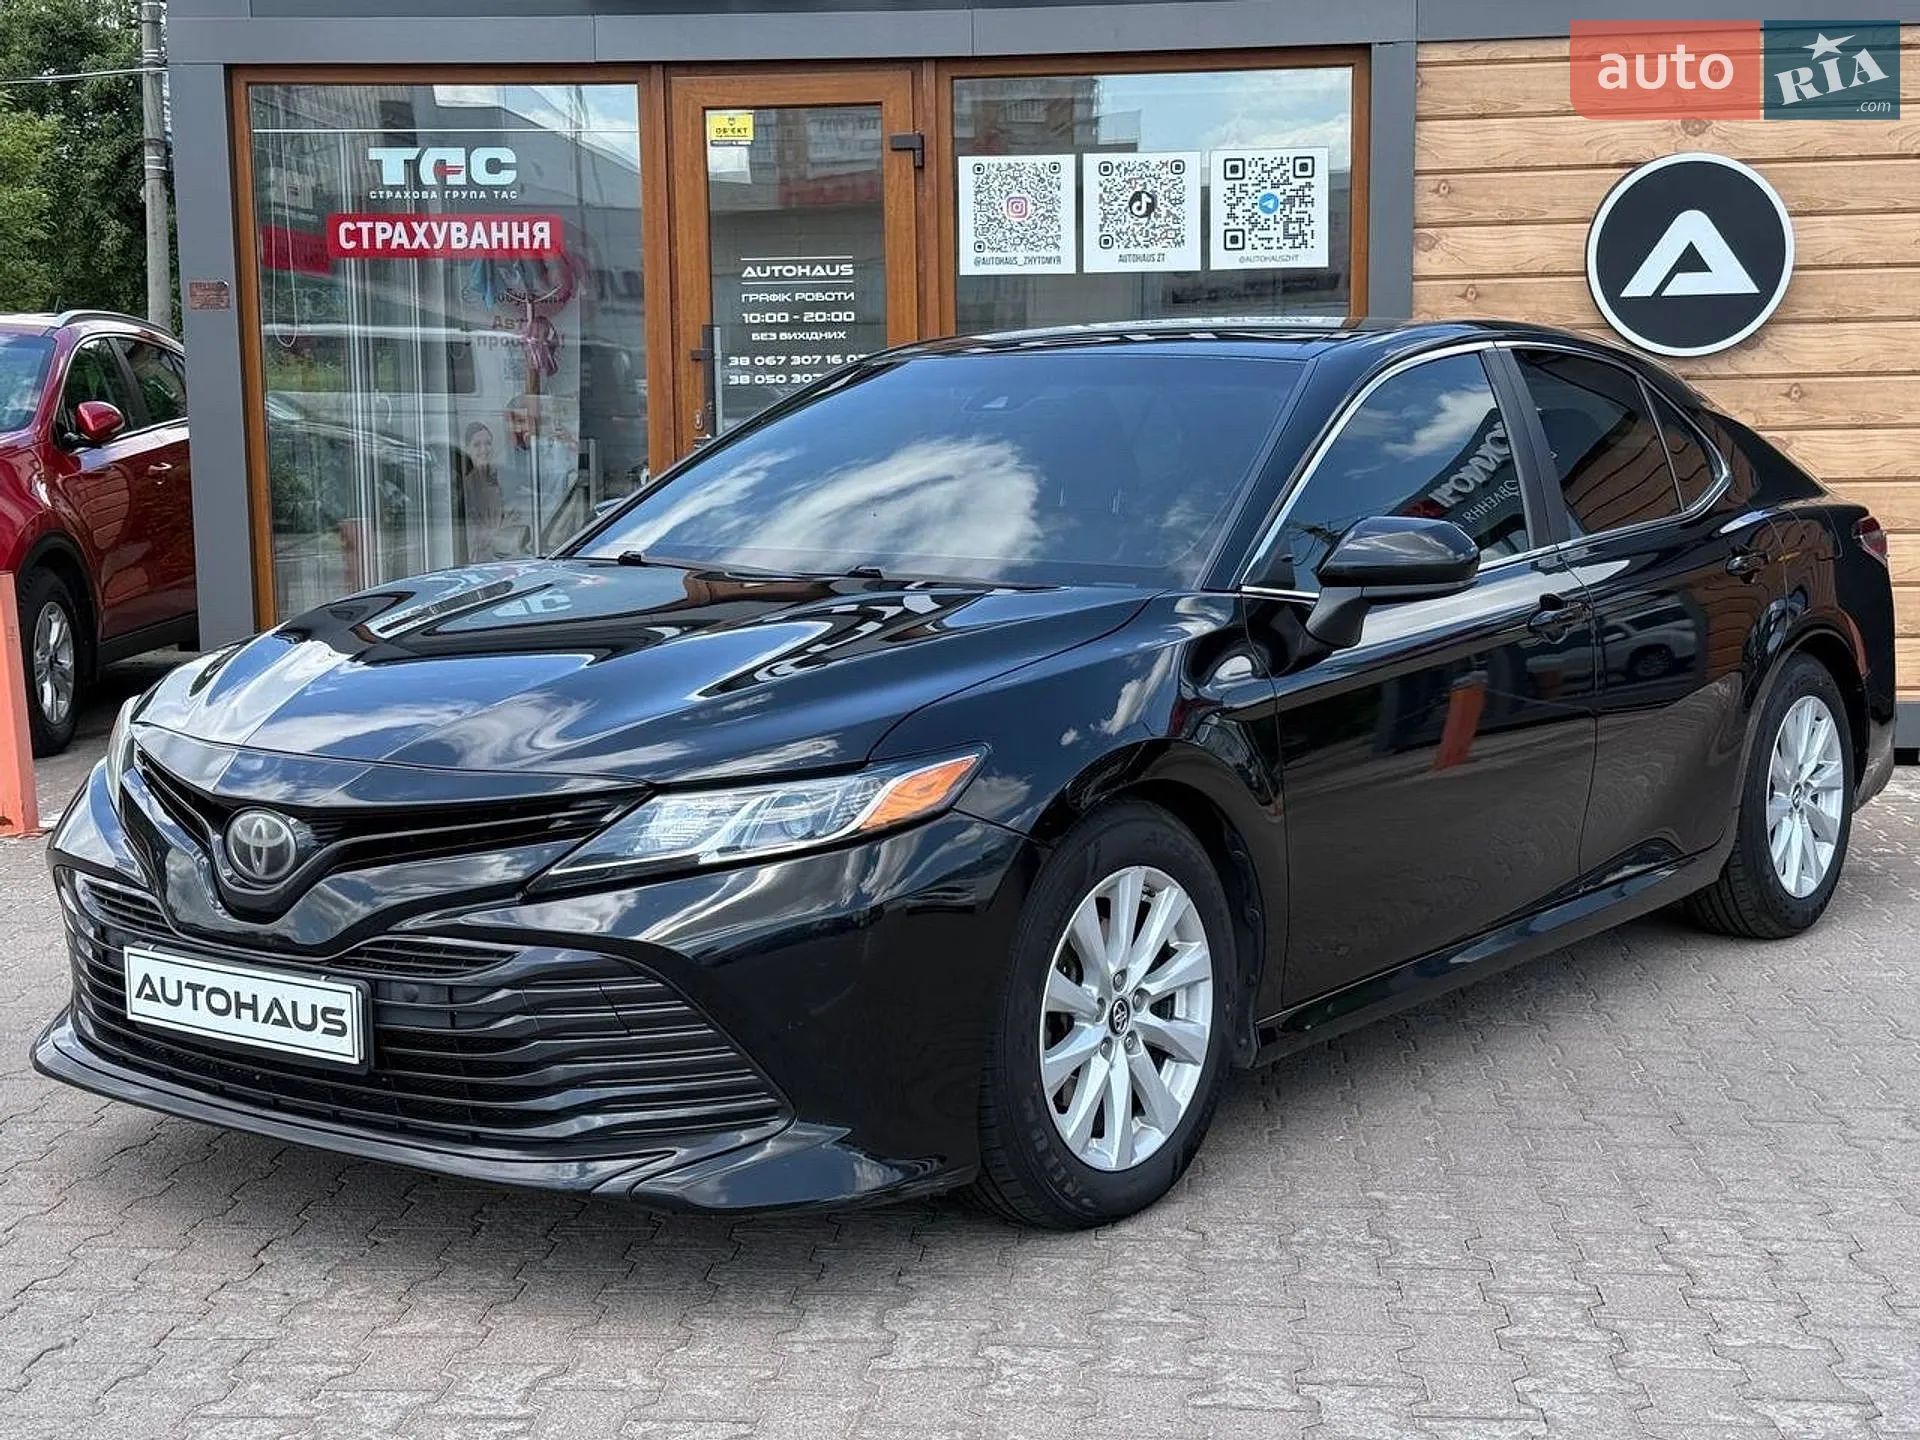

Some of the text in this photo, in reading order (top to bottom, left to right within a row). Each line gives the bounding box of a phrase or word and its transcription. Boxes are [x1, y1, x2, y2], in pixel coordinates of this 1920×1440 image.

[369, 190, 518, 200] СТРАХОВА ГРУПА ТАС
[338, 221, 551, 250] СТРАХУВАННЯ
[742, 264, 854, 278] AUTOHAUS
[741, 292, 855, 302] ГРАФІК РОБОТИ
[742, 312, 789, 323] 10:00
[803, 312, 855, 322] 20:00
[751, 331, 847, 341] БЕЗ ВИХІДНИХ
[728, 357, 750, 366] 38
[754, 356, 786, 366] 067
[790, 355, 822, 366] 307
[825, 354, 843, 365] 16
[728, 375, 750, 385] 38
[754, 374, 787, 385] 050
[135, 972, 348, 1038] AUTOHAUS
